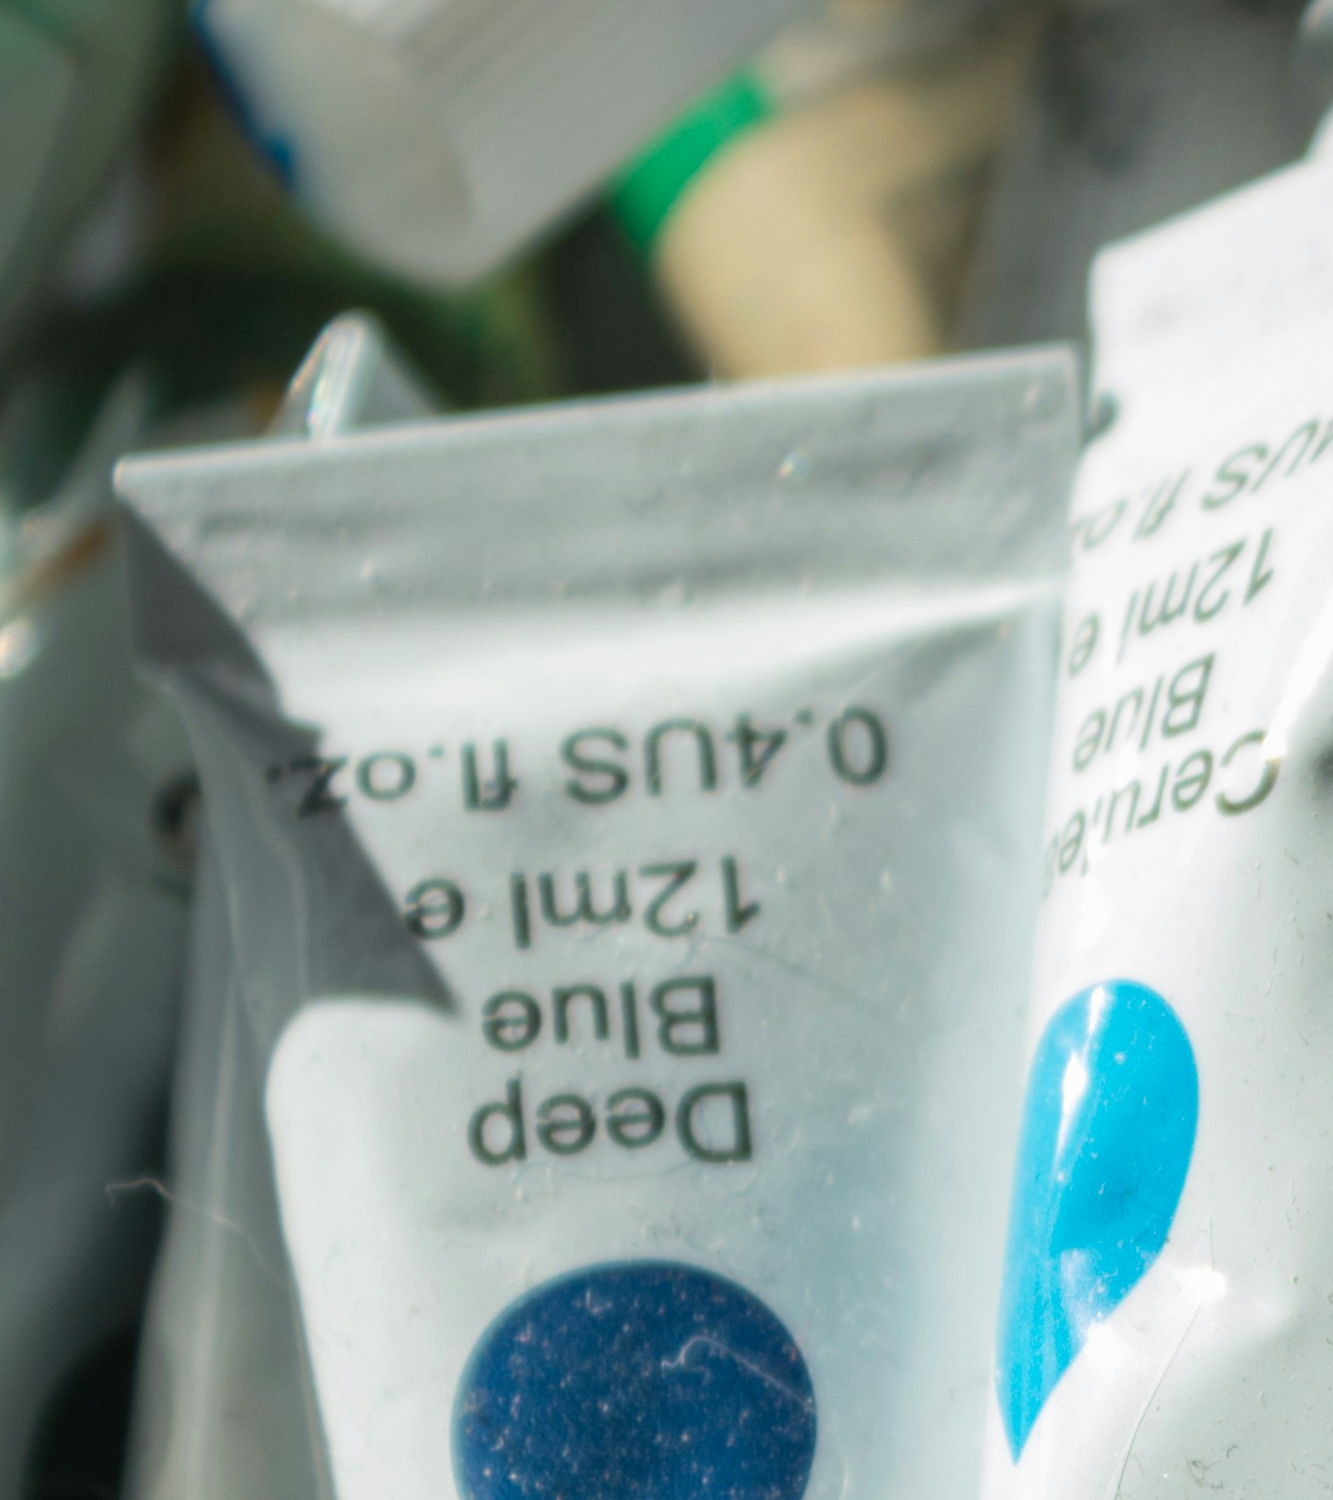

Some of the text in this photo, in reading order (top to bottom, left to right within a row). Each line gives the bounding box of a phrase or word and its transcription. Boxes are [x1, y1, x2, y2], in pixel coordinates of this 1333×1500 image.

[1119, 528, 1277, 661] 12ml
[267, 708, 888, 818] 0.4US fl.oz.
[1072, 653, 1216, 774] Blue
[509, 856, 761, 948] 12ml
[483, 976, 720, 1059] Blue
[467, 1079, 753, 1166] Deep
